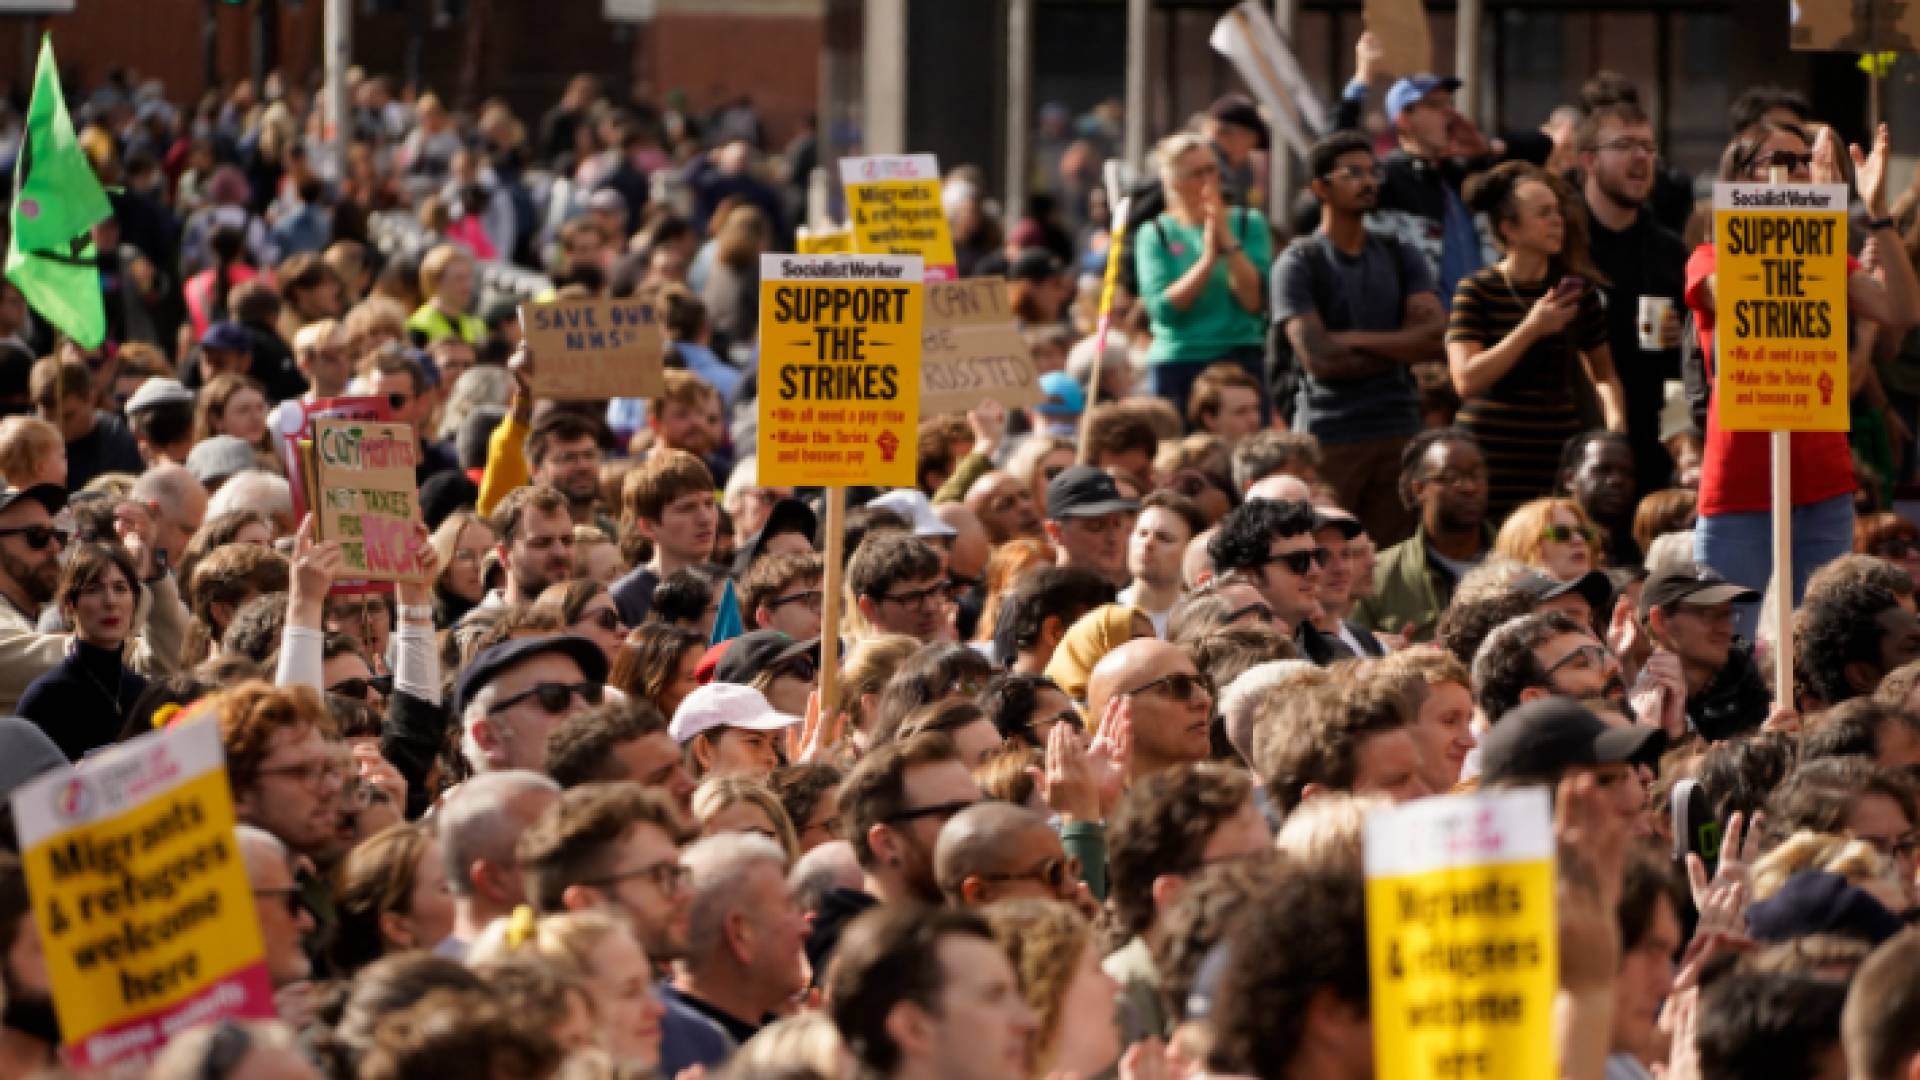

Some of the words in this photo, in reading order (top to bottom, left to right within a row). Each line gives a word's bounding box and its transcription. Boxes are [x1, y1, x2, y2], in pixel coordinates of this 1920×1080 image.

[1727, 217, 1837, 255] SUPPORT
[1761, 259, 1806, 297] THE
[534, 307, 598, 330] SAVE
[610, 304, 656, 326] OUR
[775, 287, 910, 323] SUPPORT
[1735, 300, 1831, 339] STRIKES
[813, 326, 868, 362] THE
[1753, 346, 1764, 361] all
[1769, 347, 1792, 361] need
[779, 364, 898, 400] STRIKES
[1736, 370, 1761, 385] Make
[1766, 370, 1782, 385] the
[777, 408, 796, 422] We
[800, 408, 813, 422] all
[818, 408, 846, 422] need
[858, 410, 878, 425] pay
[777, 429, 808, 443] Make
[812, 429, 832, 443] the
[777, 448, 799, 462] and
[846, 451, 865, 465] pay
[360, 489, 411, 518] TAXES
[49, 800, 206, 877] Migrants
[48, 897, 71, 936] &
[78, 839, 229, 922] refugees
[73, 891, 221, 969] welcome
[119, 953, 200, 1006] here
